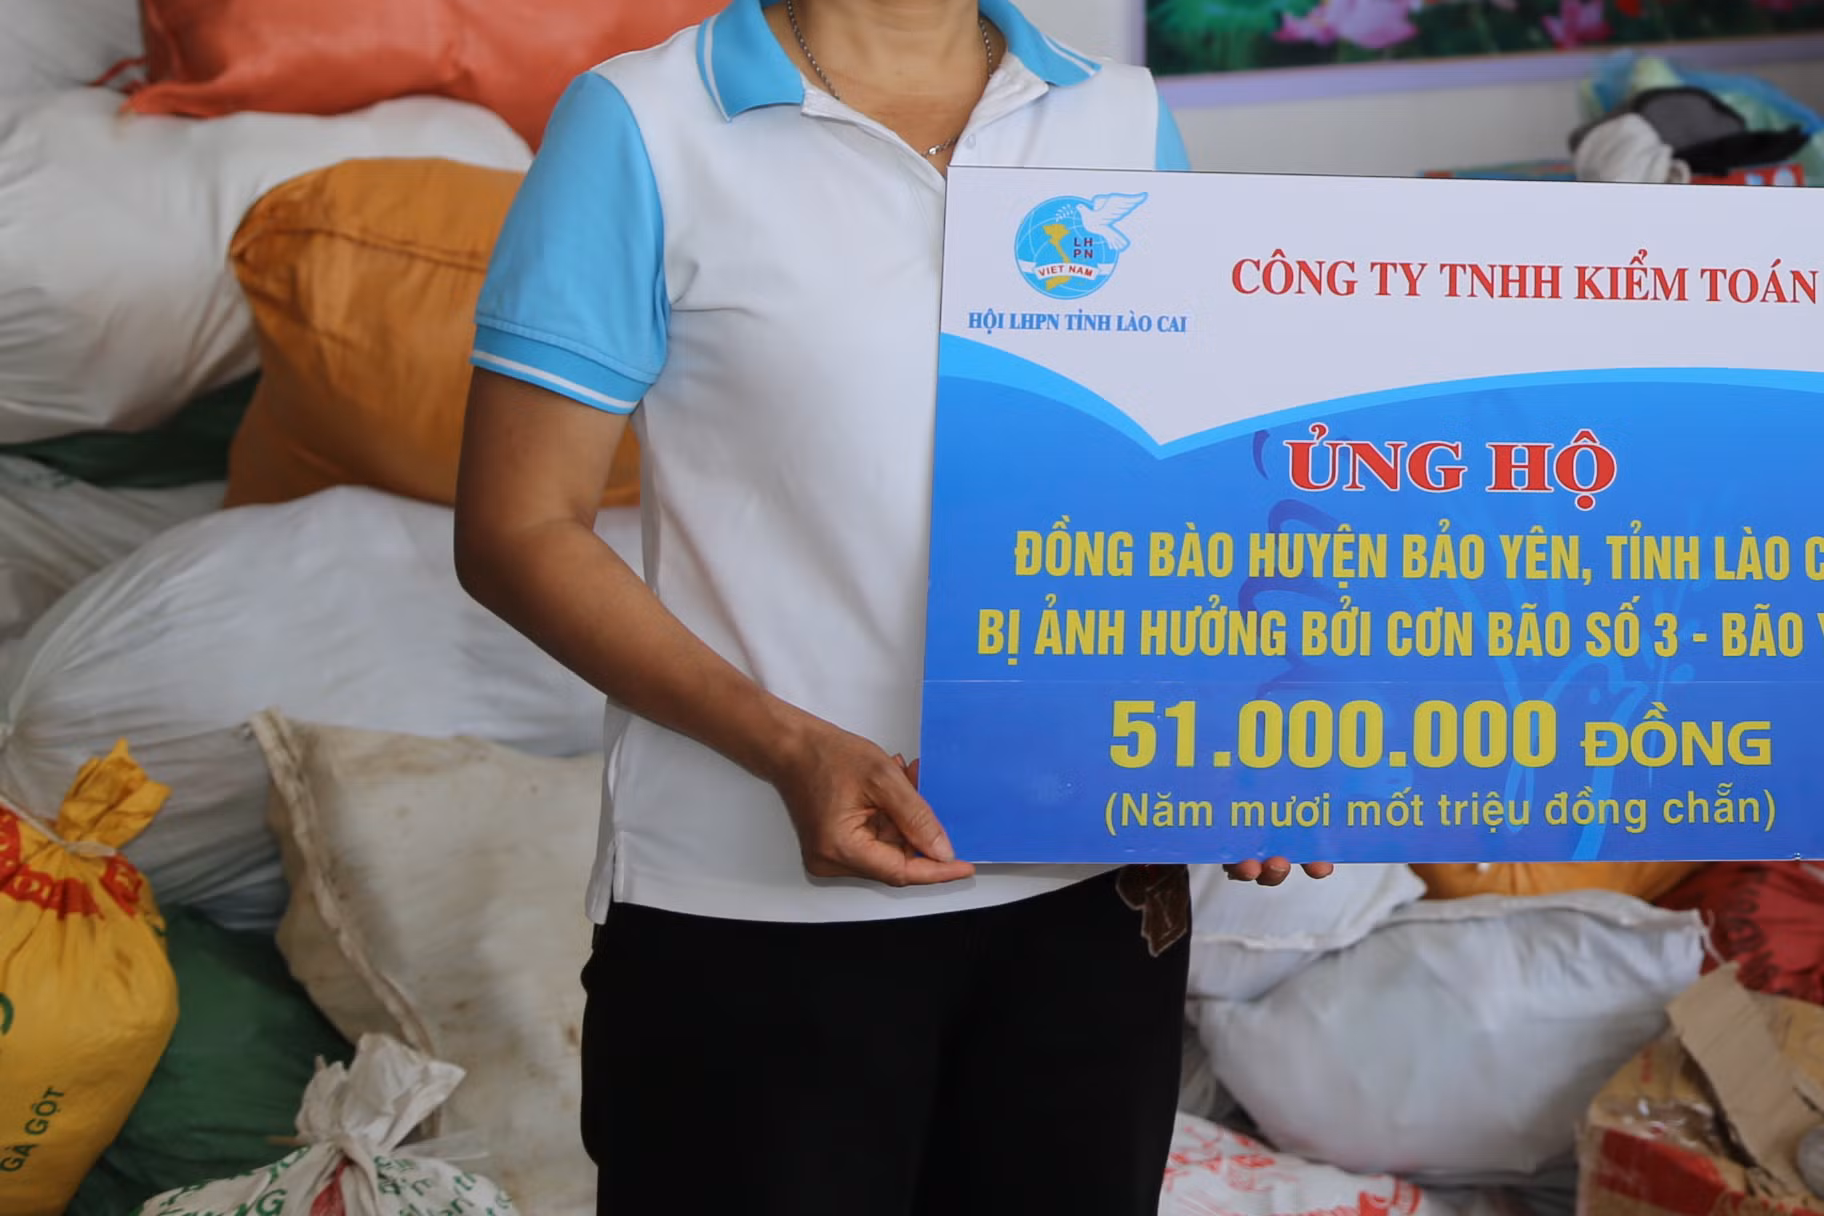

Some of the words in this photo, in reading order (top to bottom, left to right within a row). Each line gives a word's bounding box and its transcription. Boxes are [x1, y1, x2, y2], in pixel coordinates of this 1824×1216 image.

[1038, 265, 1064, 277] VIET
[1068, 265, 1094, 277] NAM
[1231, 248, 1359, 297] CÔNG
[1370, 262, 1427, 298] TY
[1440, 262, 1562, 300] TNHH
[1574, 249, 1688, 302] KIỂM
[1700, 258, 1817, 305] TOÁN
[968, 308, 1004, 335] HỘI
[1009, 312, 1060, 331] LHPN
[1065, 308, 1111, 331] TỈNH
[1117, 309, 1153, 333] LÀO
[1157, 316, 1187, 333] CAI
[1284, 422, 1468, 494] ỦNG
[1486, 429, 1618, 511] HỘ
[1015, 515, 1134, 577] ĐỒNG
[1149, 522, 1234, 578] BÀO
[1249, 524, 1388, 589] HUYỆN
[1402, 519, 1485, 580] BẢO
[1500, 525, 1593, 586] YÊN,
[1606, 520, 1699, 580] TỈNH
[1714, 526, 1790, 581] LÀO
[977, 609, 1020, 665] BỊ
[1034, 594, 1125, 655] ẢNH
[1140, 594, 1287, 657] HƯỞNG
[1302, 595, 1371, 657] BỞI
[1387, 606, 1473, 657] CƠN
[1487, 604, 1570, 657] BÃO
[1585, 595, 1641, 657] SỐ
[1654, 612, 1679, 657] 3
[1692, 631, 1708, 643] -
[1722, 604, 1803, 657] BÃO
[1109, 699, 1557, 769] 51.000.000
[1580, 702, 1773, 767] ĐỒNG
[1105, 791, 1213, 836] (Năm
[1231, 793, 1331, 828] mươi
[1346, 786, 1424, 827] mốt
[1437, 791, 1531, 834] triệu
[1544, 785, 1648, 834] đồng
[1662, 782, 1777, 832] chẵn)
